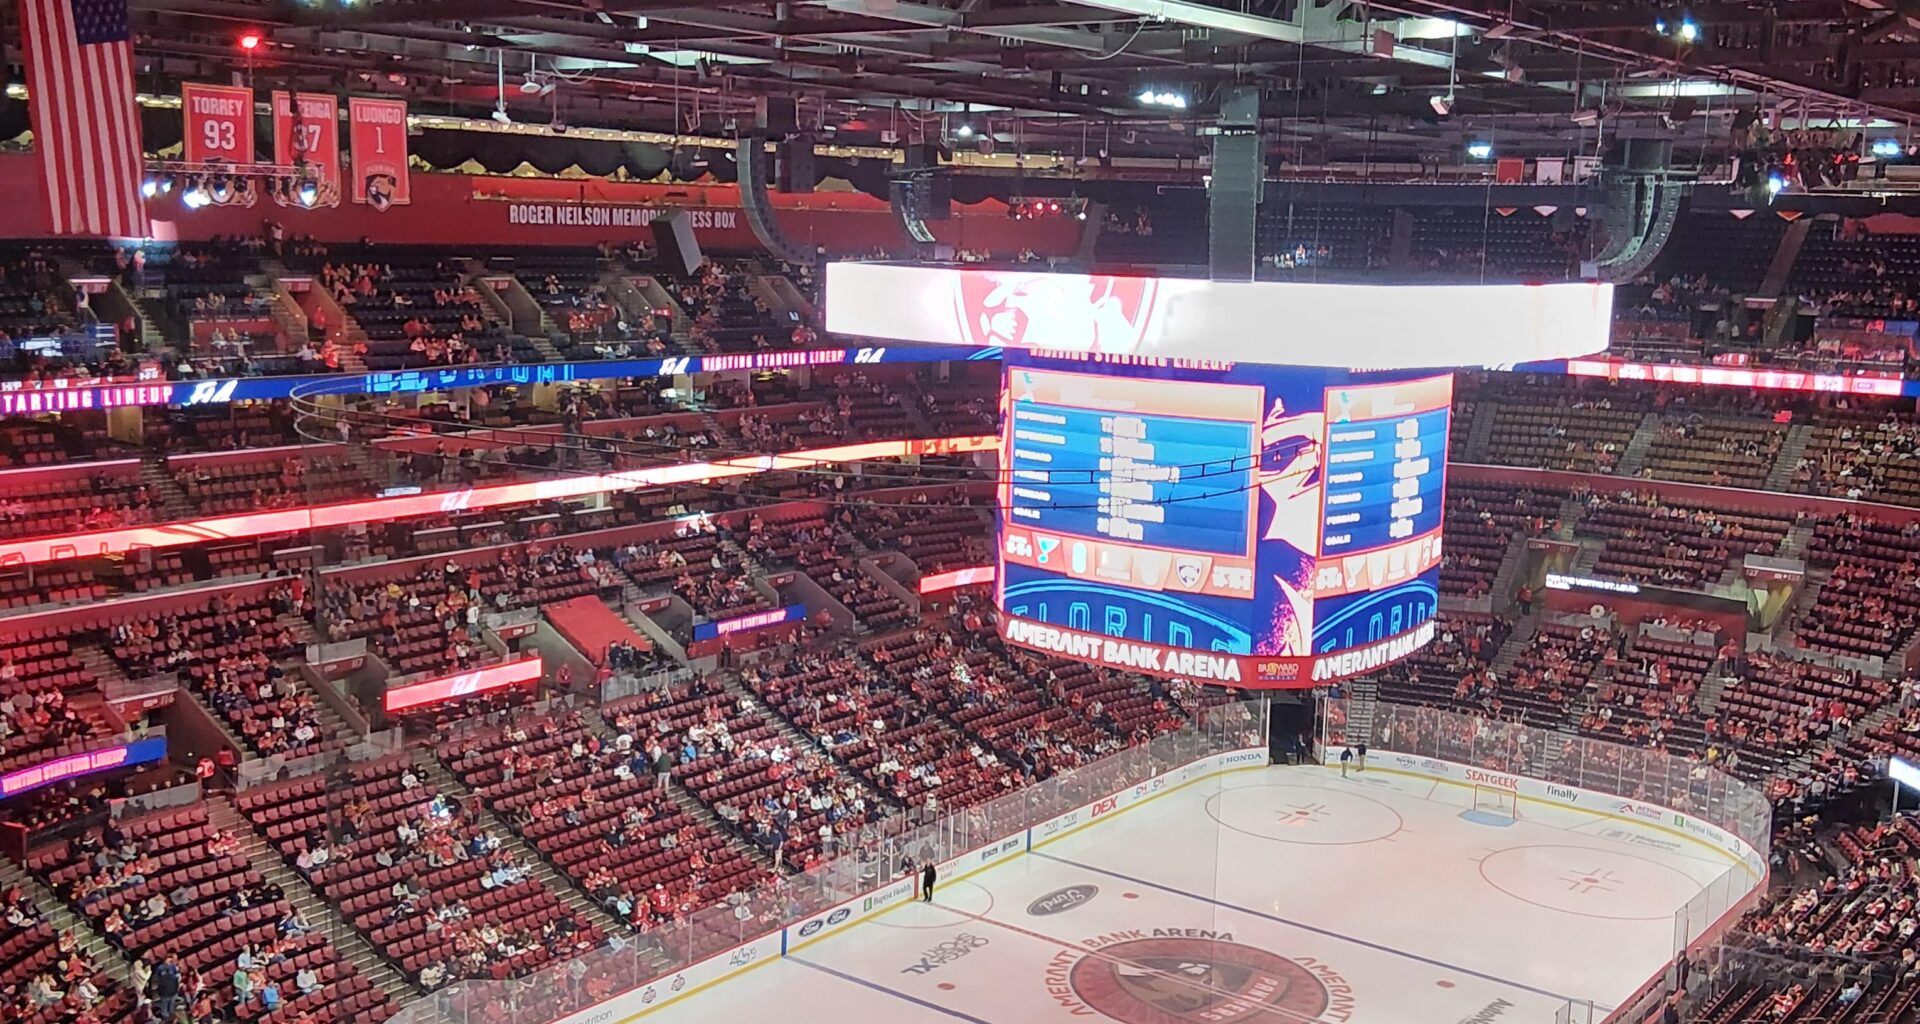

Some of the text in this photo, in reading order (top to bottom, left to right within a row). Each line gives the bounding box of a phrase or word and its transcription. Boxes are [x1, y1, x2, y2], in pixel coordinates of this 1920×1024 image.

[193, 97, 243, 117] TORREY
[355, 106, 401, 124] LUONGO
[203, 120, 236, 150] 93
[294, 124, 321, 152] 37
[374, 126, 385, 154] 1
[510, 205, 553, 224] ROGER
[556, 206, 610, 226] NEILSON
[714, 211, 736, 228] BOX
[702, 350, 846, 371] VISITING STARTING LINEUP
[101, 386, 173, 406] LINEUP
[1006, 620, 1241, 682] AMERANT BANK ARENA
[1312, 644, 1389, 681] AMERANT
[1226, 752, 1262, 764] HONDA
[1465, 769, 1519, 790] SEATGEEK
[1546, 785, 1578, 802] finally
[1091, 795, 1119, 817] DEX
[1038, 887, 1084, 912] Ford
[1044, 928, 1235, 1017] AMERANT BANK ARENA
[1199, 976, 1279, 1021] PANTHERS
